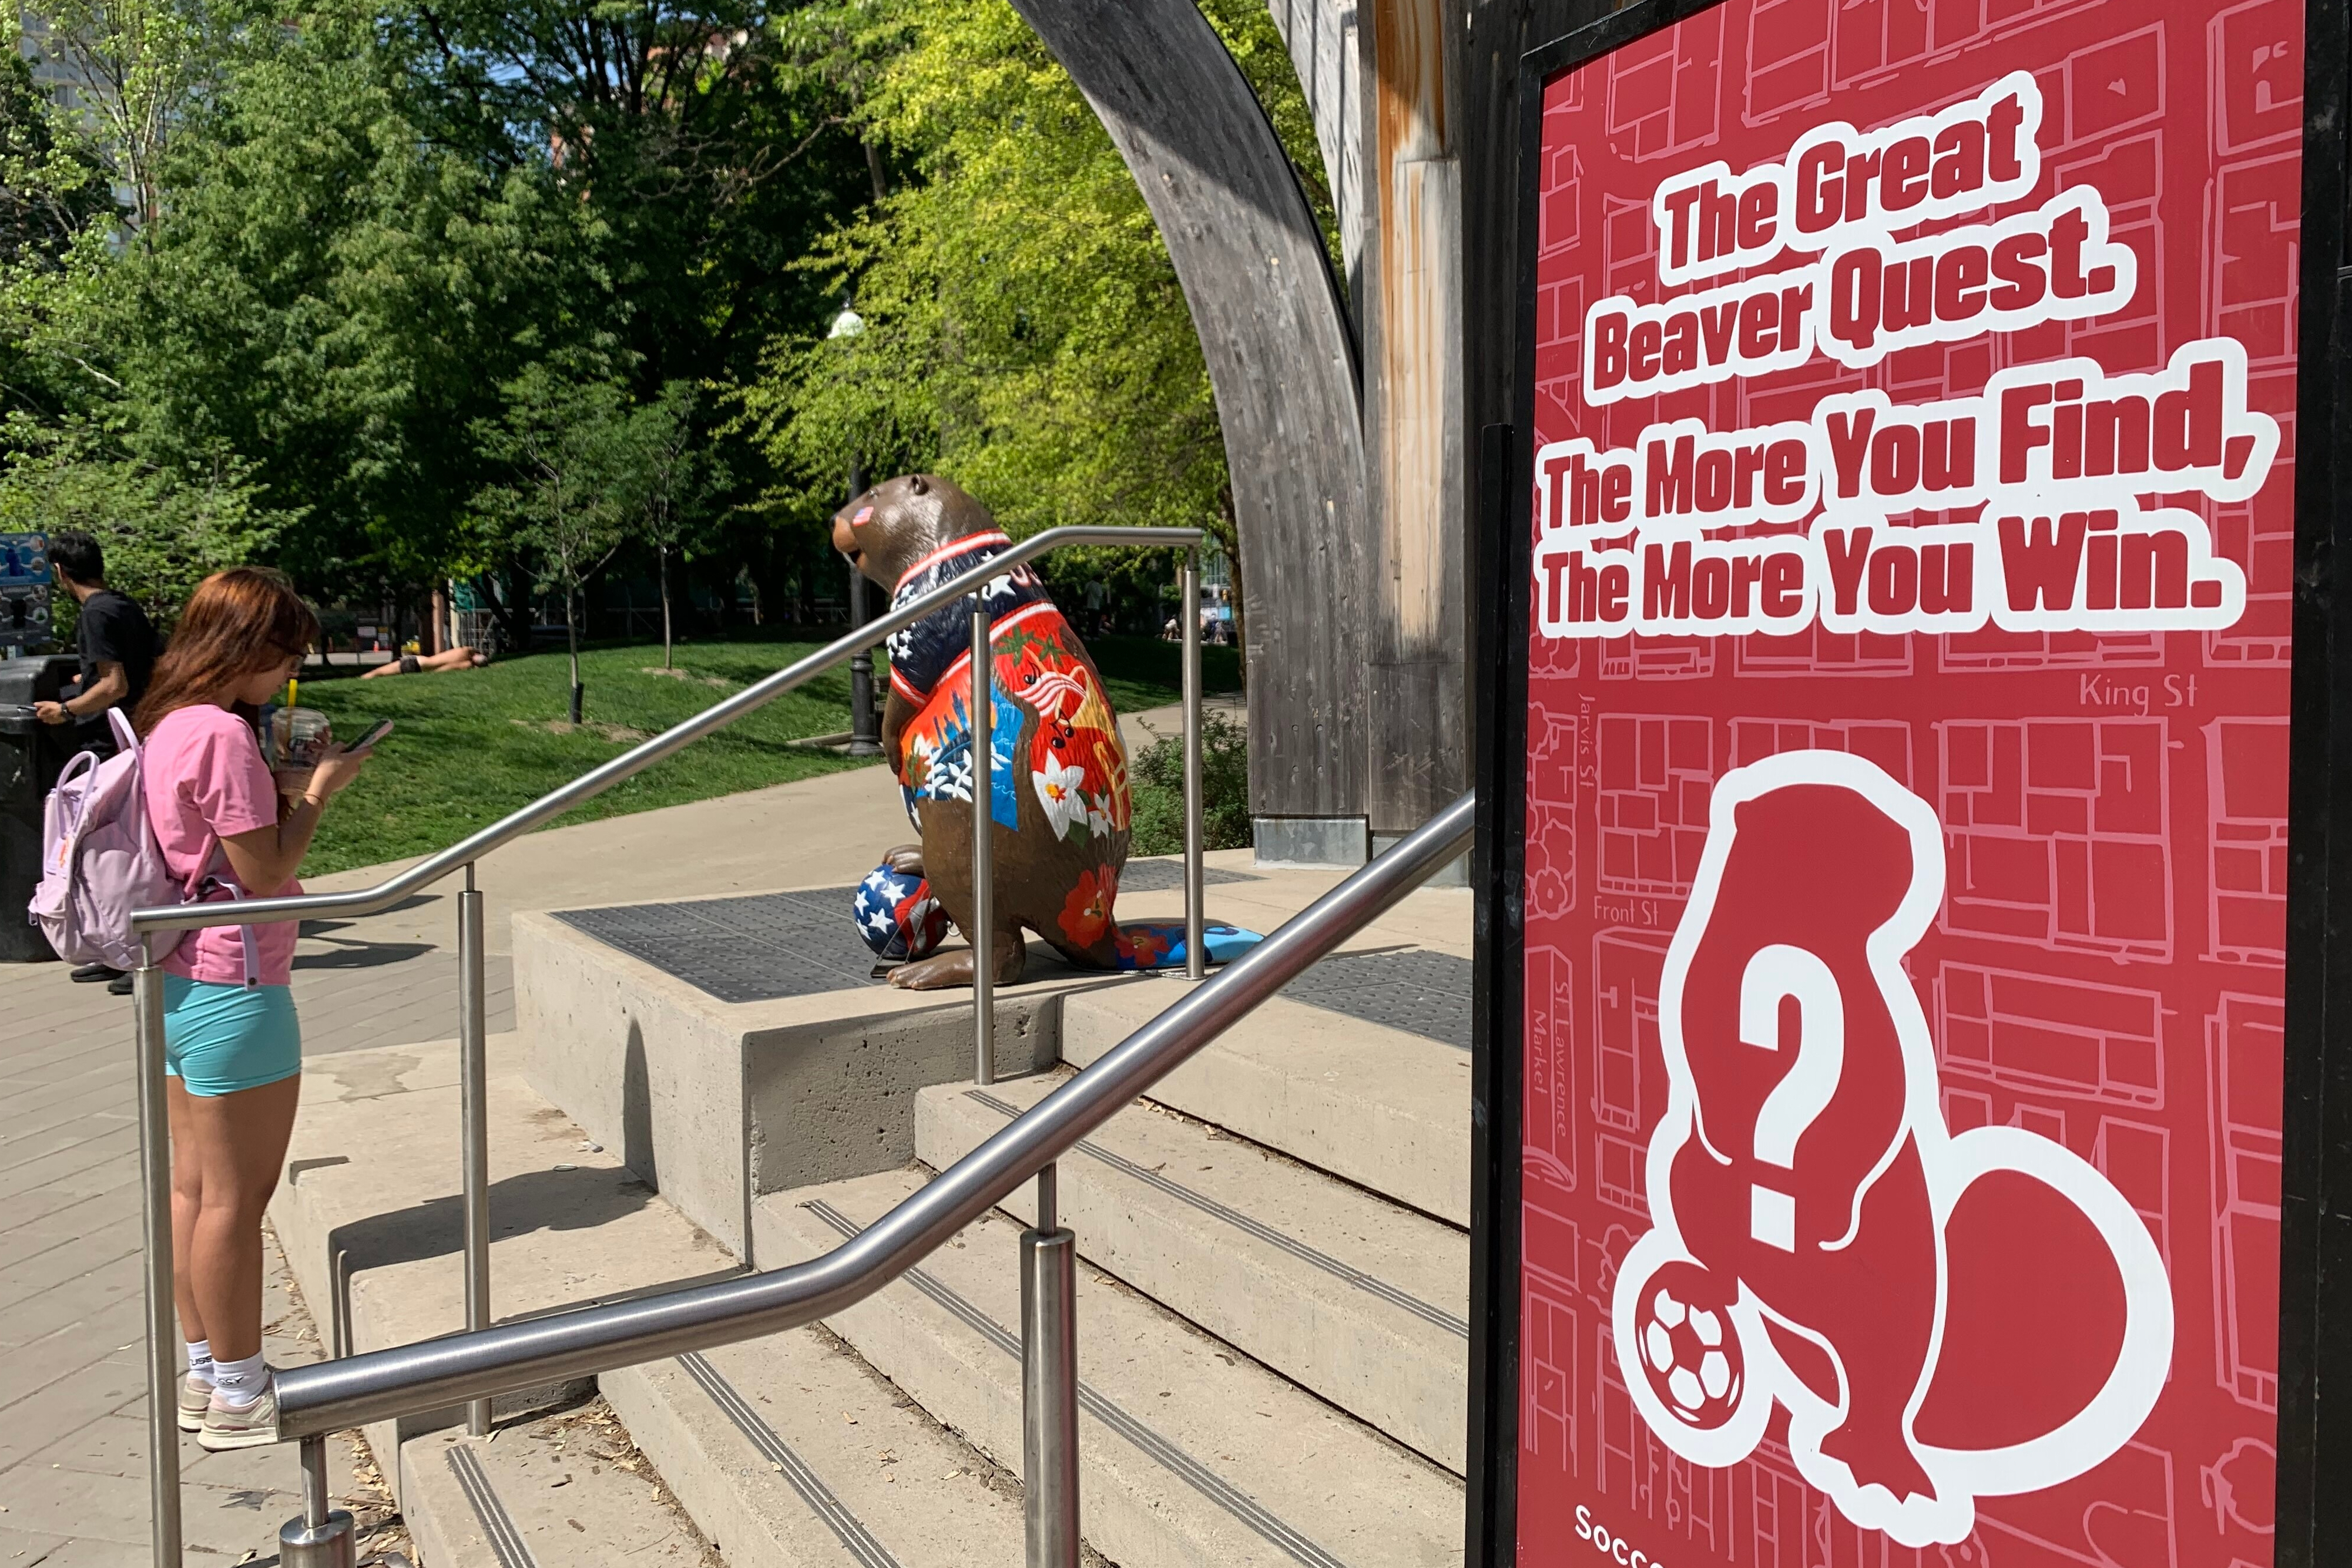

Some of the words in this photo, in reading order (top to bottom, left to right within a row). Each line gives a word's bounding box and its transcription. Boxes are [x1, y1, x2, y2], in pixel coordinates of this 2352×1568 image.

[1663, 178, 1778, 270] The
[1795, 91, 2024, 233] Great
[1593, 281, 1813, 391] Beaver
[1829, 206, 2116, 350] Quest.
[1544, 452, 1632, 529] The
[1645, 434, 1807, 518] More
[1825, 407, 1976, 499] You
[1999, 360, 2256, 484] Find,
[1542, 550, 1630, 623] The
[1642, 540, 1804, 620] More
[1823, 526, 1974, 616] You
[1997, 509, 2222, 612] Win.
[1578, 692, 1596, 755] Jarvis
[2079, 673, 2150, 716] King
[2163, 673, 2198, 707] St
[1579, 764, 1595, 788] St
[1593, 895, 1635, 924] Front
[1641, 899, 1659, 926] St
[1555, 981, 1569, 1009] St.
[1533, 1009, 1548, 1094] Market
[1555, 1018, 1569, 1137] Lawrence
[1575, 1504, 1665, 1568] Socc
